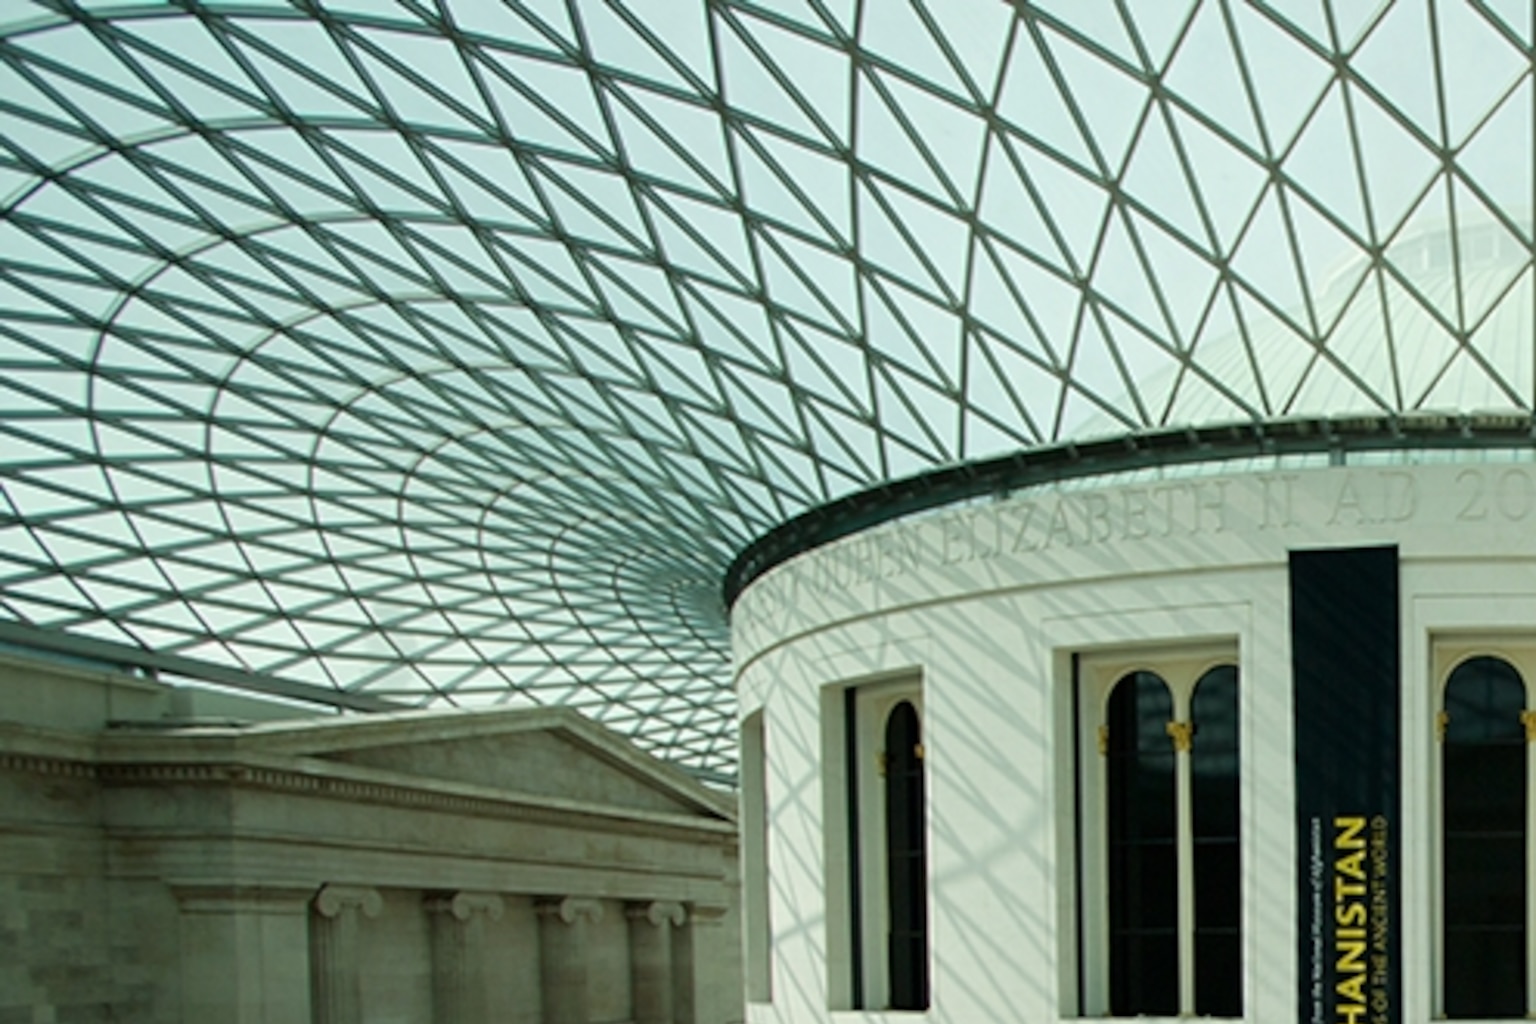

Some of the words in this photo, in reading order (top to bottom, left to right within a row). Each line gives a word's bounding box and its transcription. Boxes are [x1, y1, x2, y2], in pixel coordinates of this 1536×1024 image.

[940, 481, 1227, 566] ELIZABETH
[1256, 475, 1301, 529] II
[1372, 815, 1388, 878] WORLD
[1371, 881, 1388, 952] ANCIENT
[1371, 955, 1388, 985] THE
[1371, 990, 1388, 1013] OF
